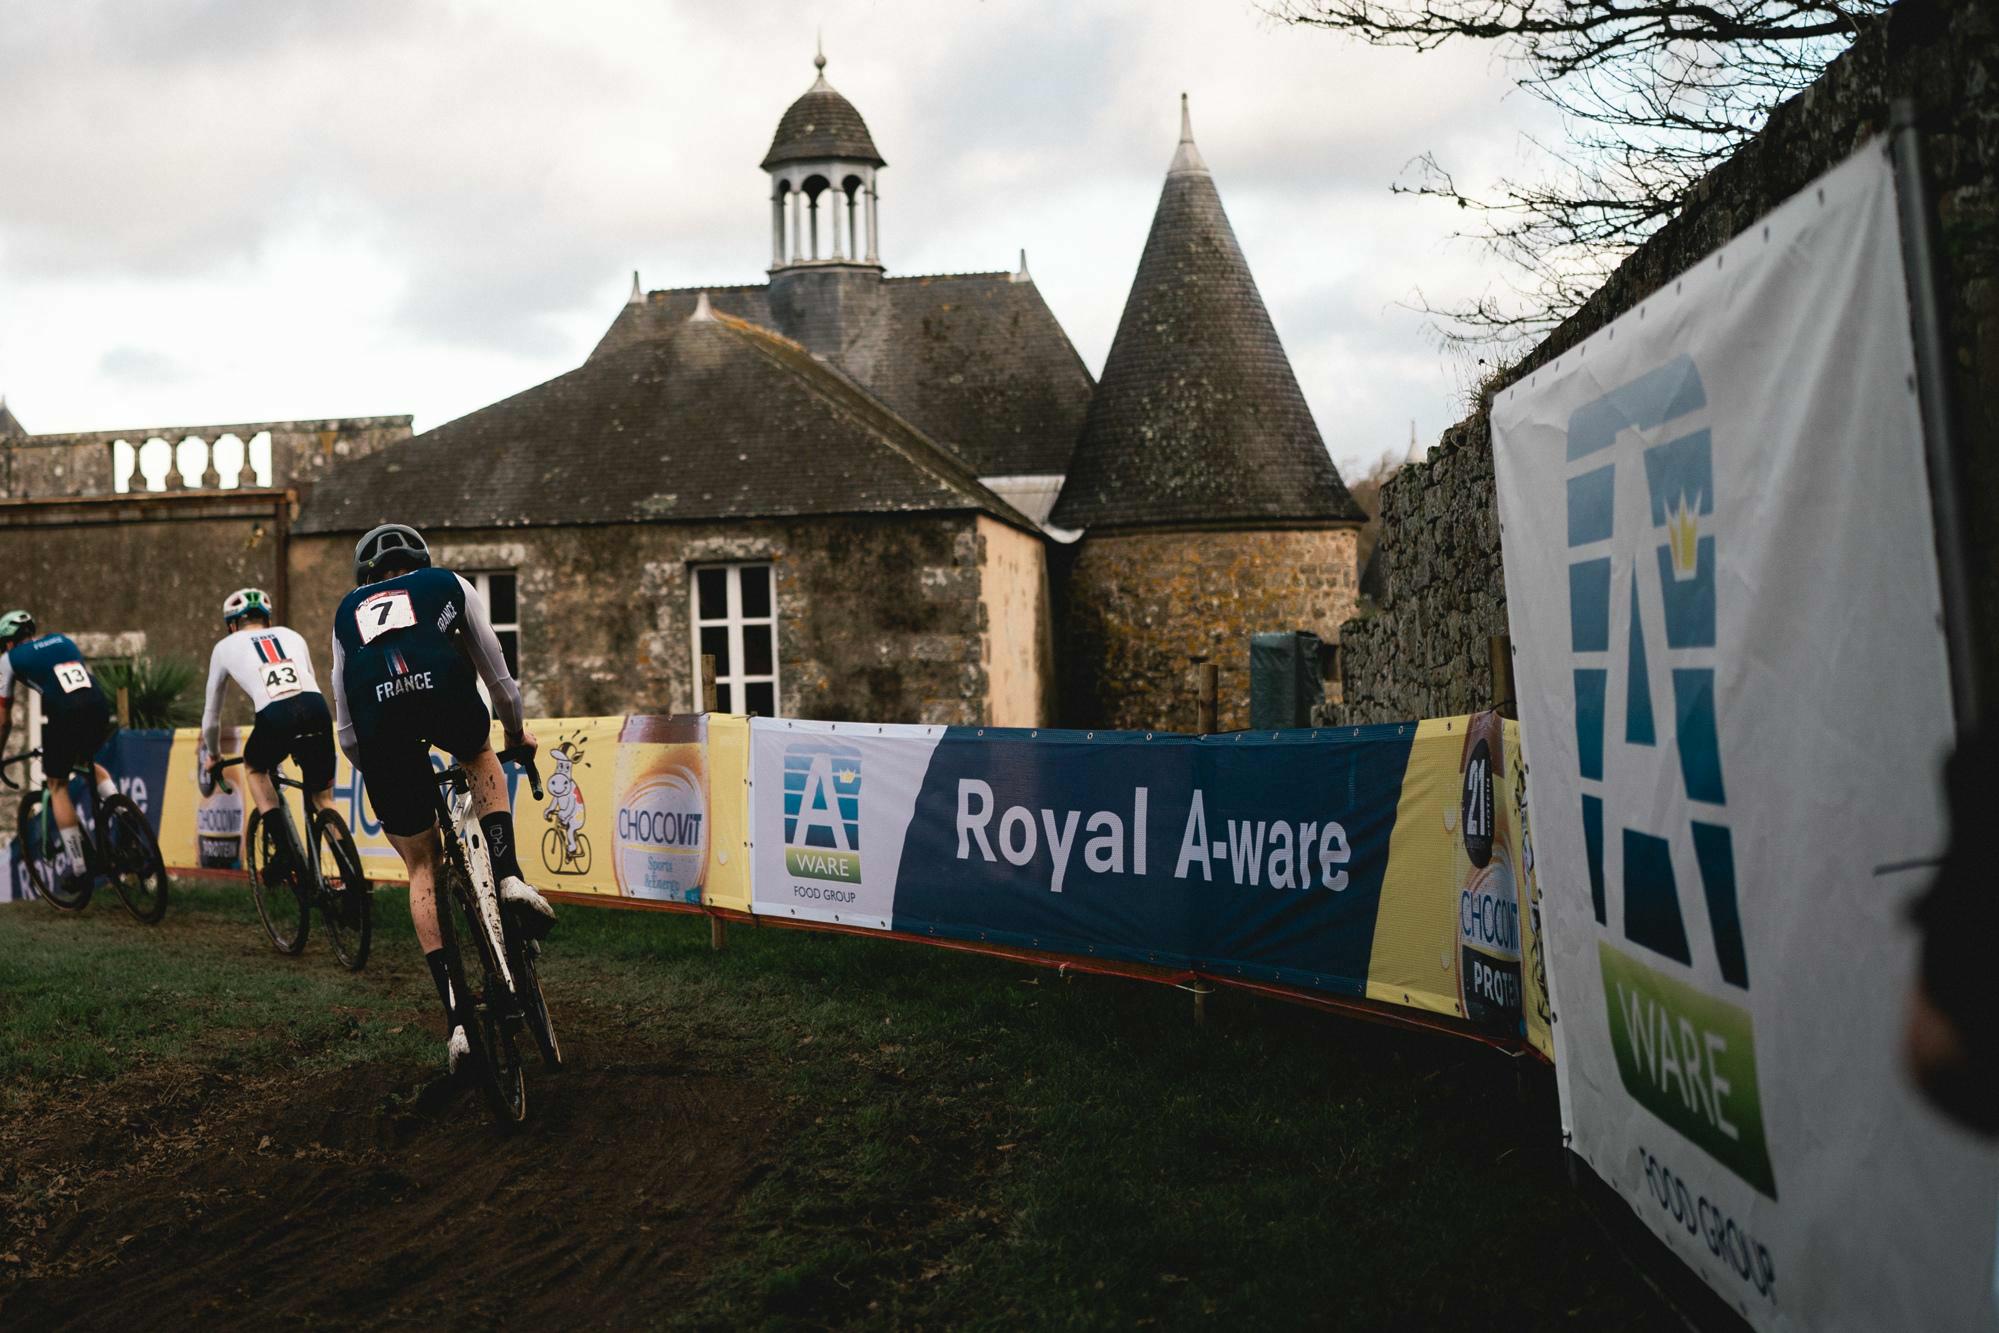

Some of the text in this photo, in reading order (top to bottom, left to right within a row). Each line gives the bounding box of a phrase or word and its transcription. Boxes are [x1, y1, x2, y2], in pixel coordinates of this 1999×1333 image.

[370, 600, 393, 626] 7
[437, 600, 458, 633] FRANCE
[62, 669, 85, 685] 13
[266, 667, 298, 687] 43
[376, 671, 434, 703] FRANCE
[1466, 758, 1486, 836] 21
[956, 777, 1352, 893] Royal A-ware
[796, 853, 850, 877] WARE
[794, 886, 856, 903] FOOD GROUP
[1616, 981, 1740, 1142] WARE
[1639, 1146, 1779, 1306] FOOD GROUP
